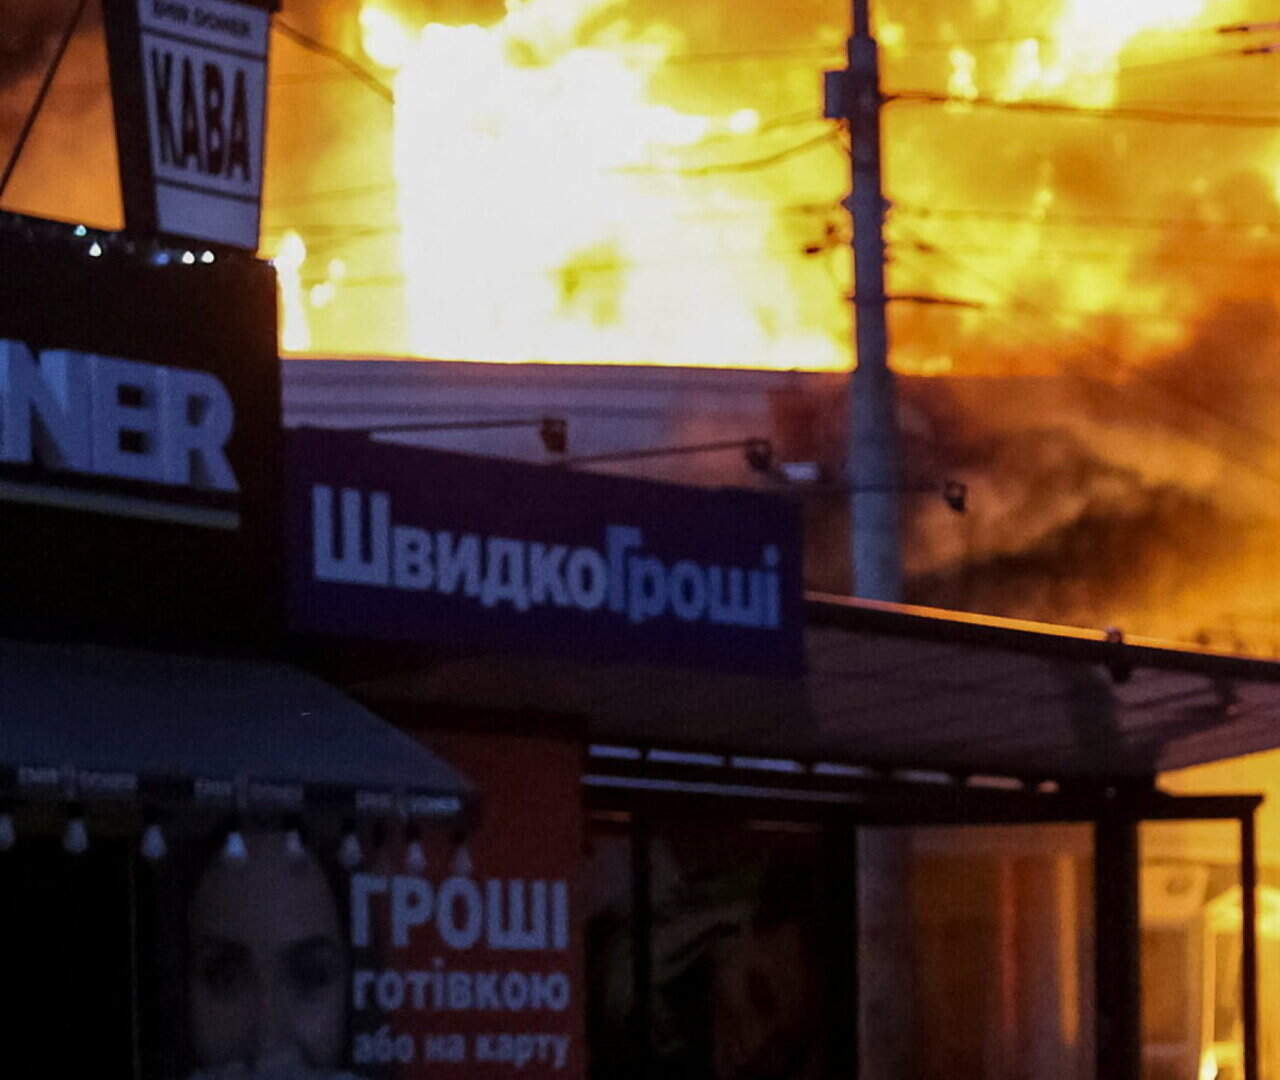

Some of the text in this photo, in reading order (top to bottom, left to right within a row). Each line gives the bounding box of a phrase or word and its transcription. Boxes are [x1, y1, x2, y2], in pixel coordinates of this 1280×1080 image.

[151, 48, 251, 181] КАВА
[311, 483, 783, 630] ШвидкоГроші
[351, 873, 569, 950] ГРОШІ
[352, 956, 571, 1012] готівкою
[353, 1024, 572, 1069] або на карту
